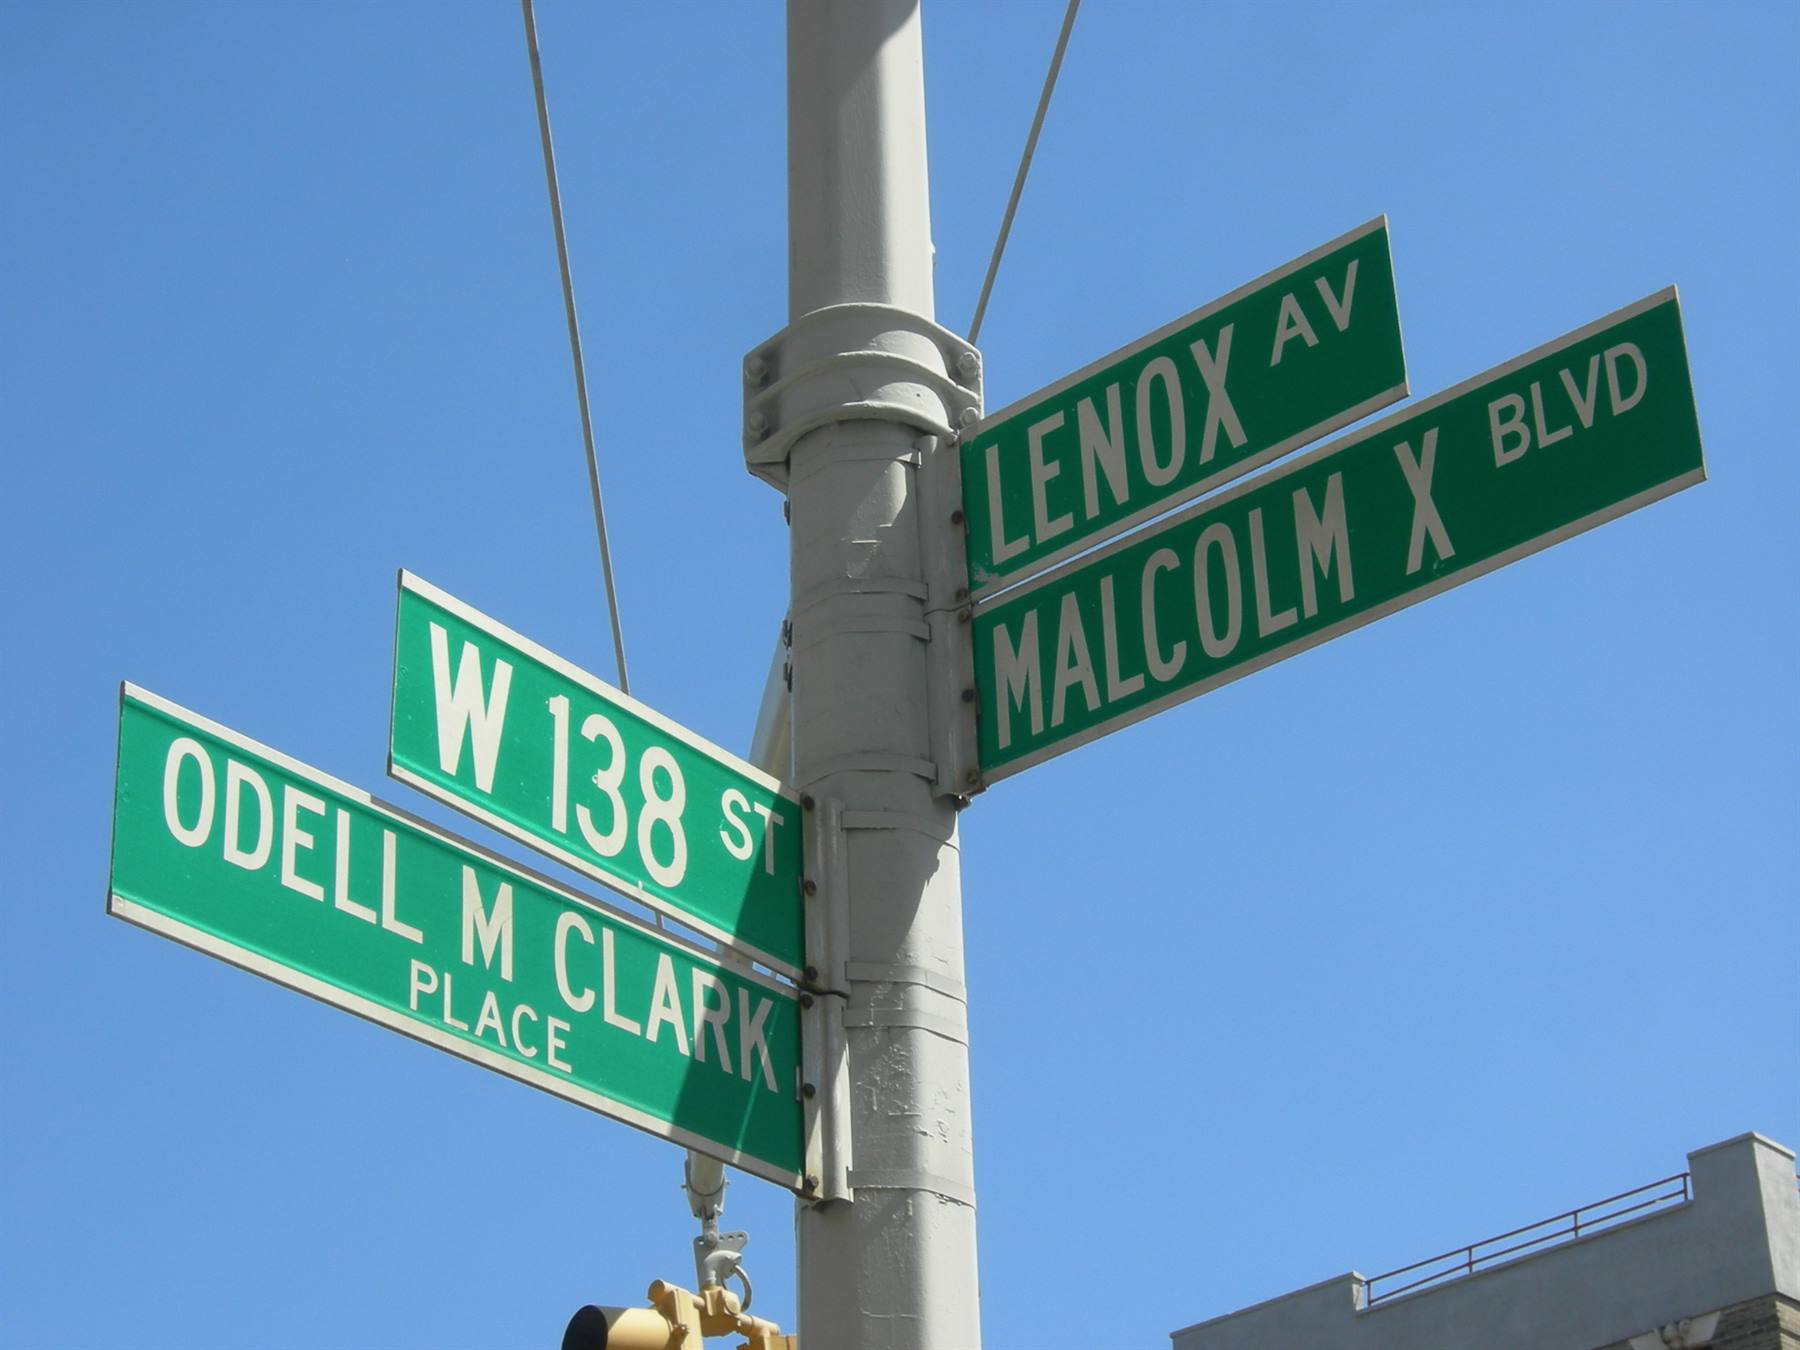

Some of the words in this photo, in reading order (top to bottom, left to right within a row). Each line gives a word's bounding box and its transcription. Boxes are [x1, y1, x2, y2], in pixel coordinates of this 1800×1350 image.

[986, 323, 1248, 566] LENOX
[1270, 259, 1359, 367] AV
[993, 471, 1355, 749] MALCOLM
[1393, 427, 1456, 575] X
[1487, 342, 1649, 468] BLVD
[429, 621, 514, 794] W
[545, 694, 688, 888] 138
[719, 788, 785, 875] ST
[163, 737, 423, 945] ODELL
[462, 865, 513, 982] M
[554, 911, 779, 1093] CLARK
[409, 958, 572, 1073] PLACE
